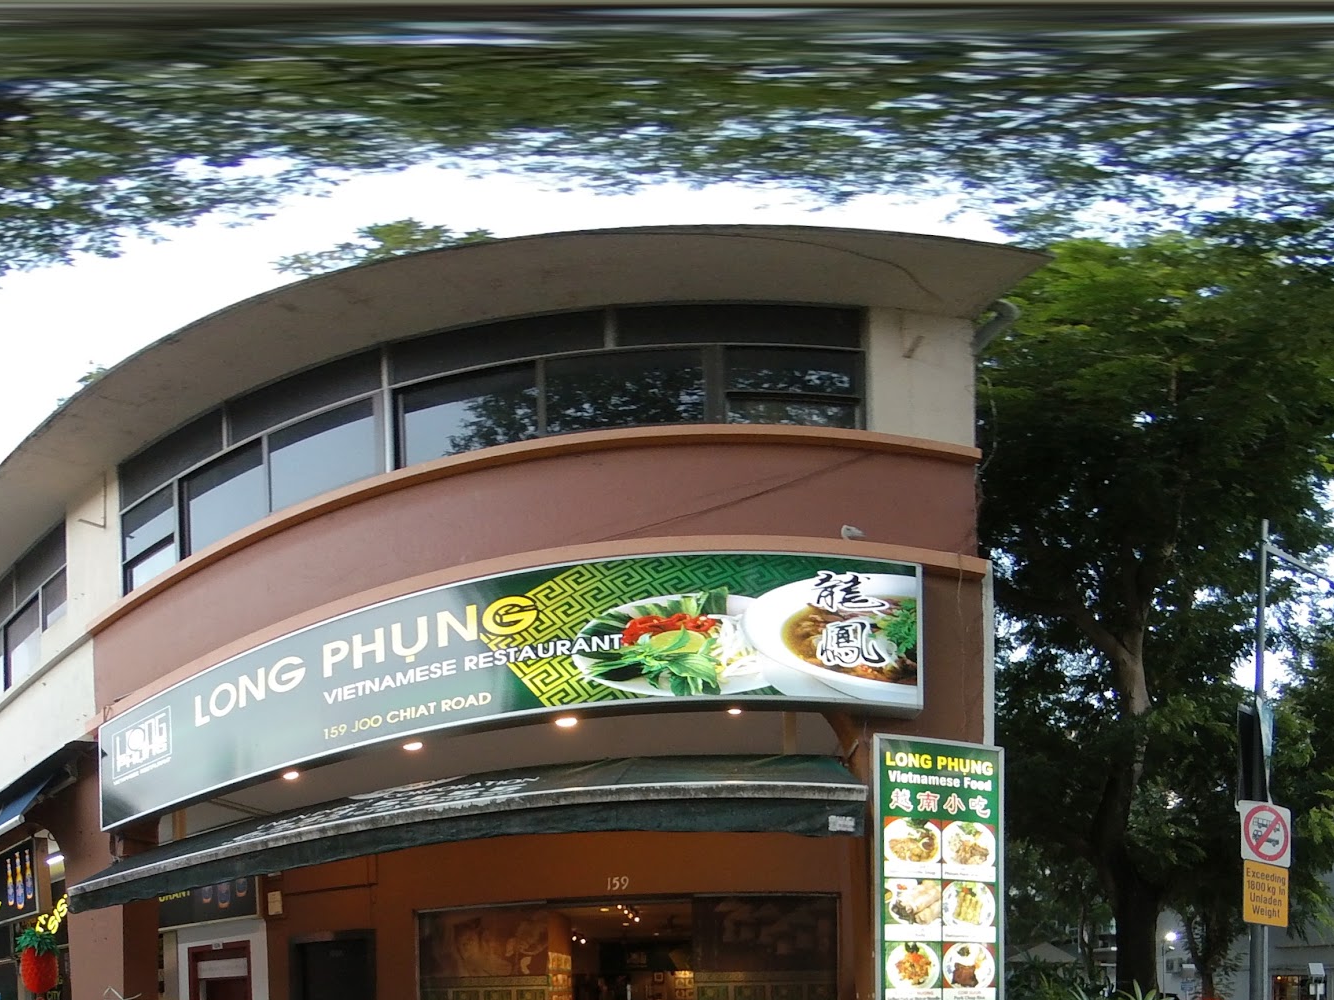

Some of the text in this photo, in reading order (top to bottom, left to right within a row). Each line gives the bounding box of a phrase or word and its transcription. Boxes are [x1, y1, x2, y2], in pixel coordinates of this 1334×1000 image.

[812, 569, 891, 668] 龍鳳
[193, 595, 541, 728] LONG PHỤNG
[323, 633, 622, 705] VIETNAMESE RESTAURANT
[323, 691, 493, 740] 159 JOO CHIAT ROAD
[885, 751, 994, 777] LONG PHỤNG
[888, 770, 993, 792] Vietnamese Food
[889, 788, 991, 818] 越南小吃
[607, 875, 630, 891] 159
[1246, 867, 1286, 886] Exceeding
[1247, 880, 1266, 892] 1800
[1267, 884, 1276, 896] kg
[1249, 892, 1282, 907] Unladen
[1251, 904, 1280, 919] Weight
